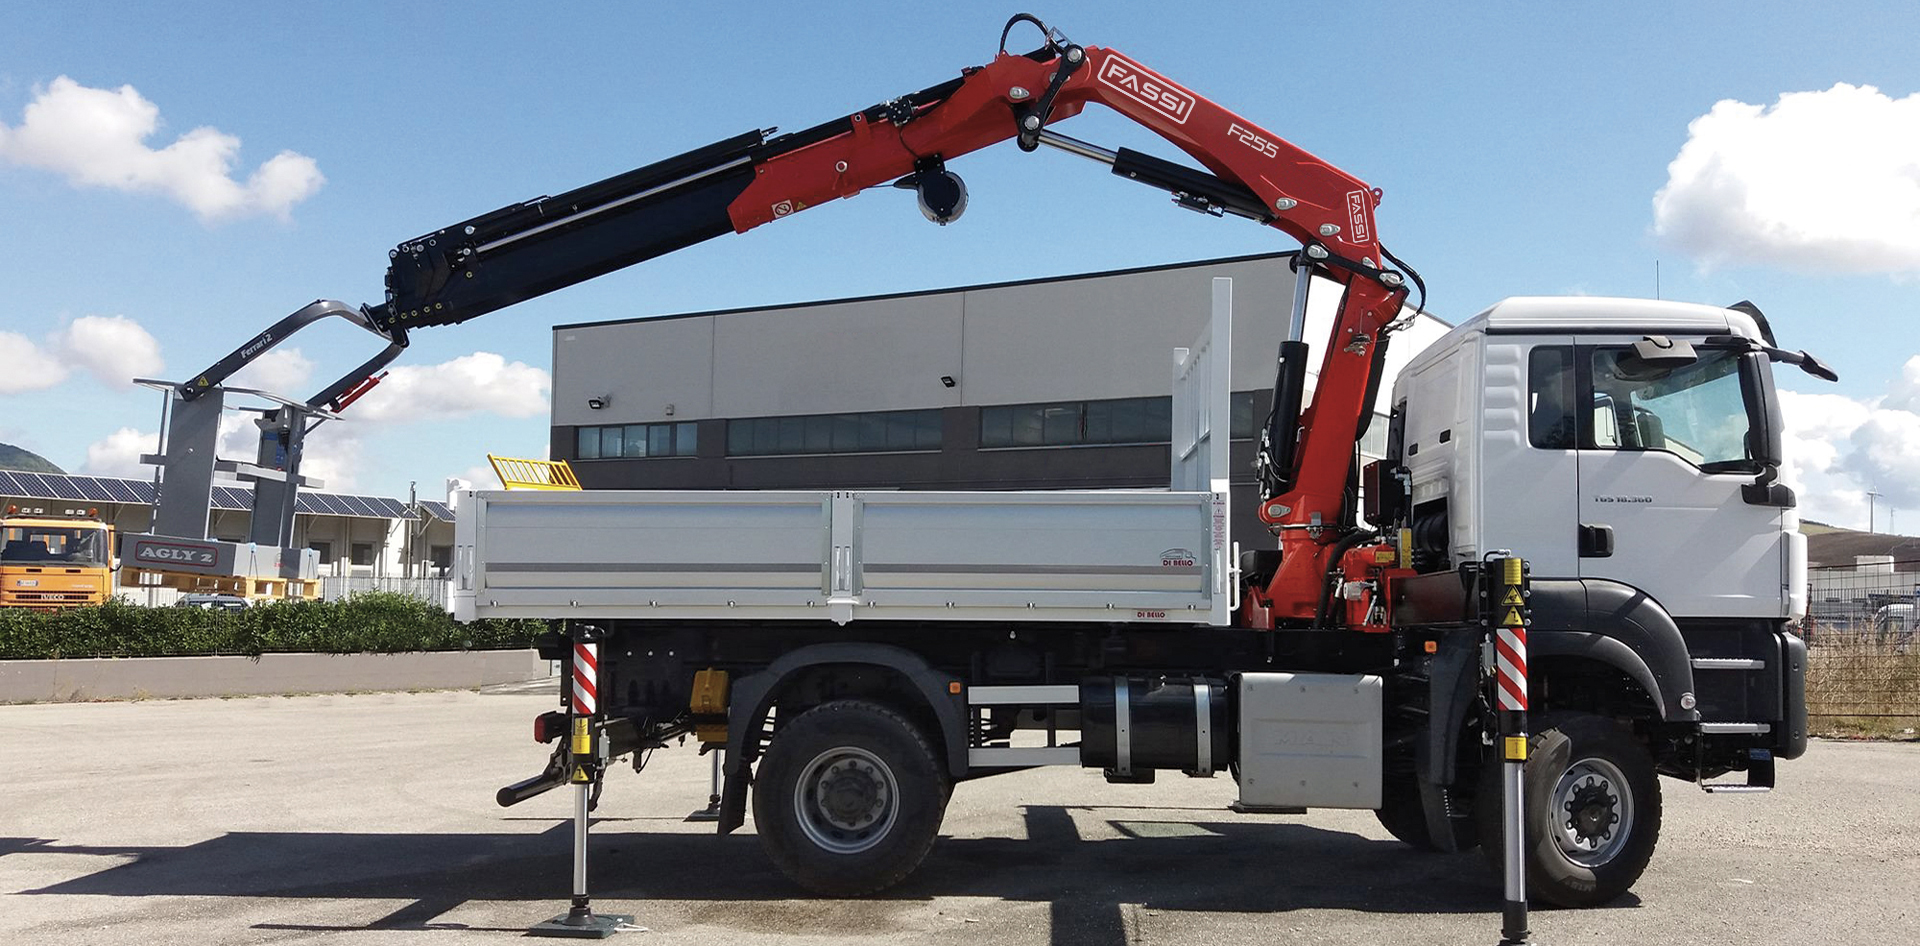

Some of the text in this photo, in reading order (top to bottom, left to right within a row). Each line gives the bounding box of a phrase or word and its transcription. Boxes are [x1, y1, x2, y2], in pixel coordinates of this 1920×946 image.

[1107, 63, 1186, 115] FASSI
[1227, 122, 1279, 159] F255
[1351, 194, 1366, 239] FASSI
[240, 333, 273, 359] Ferrari 2
[140, 546, 213, 563] AGLY 2
